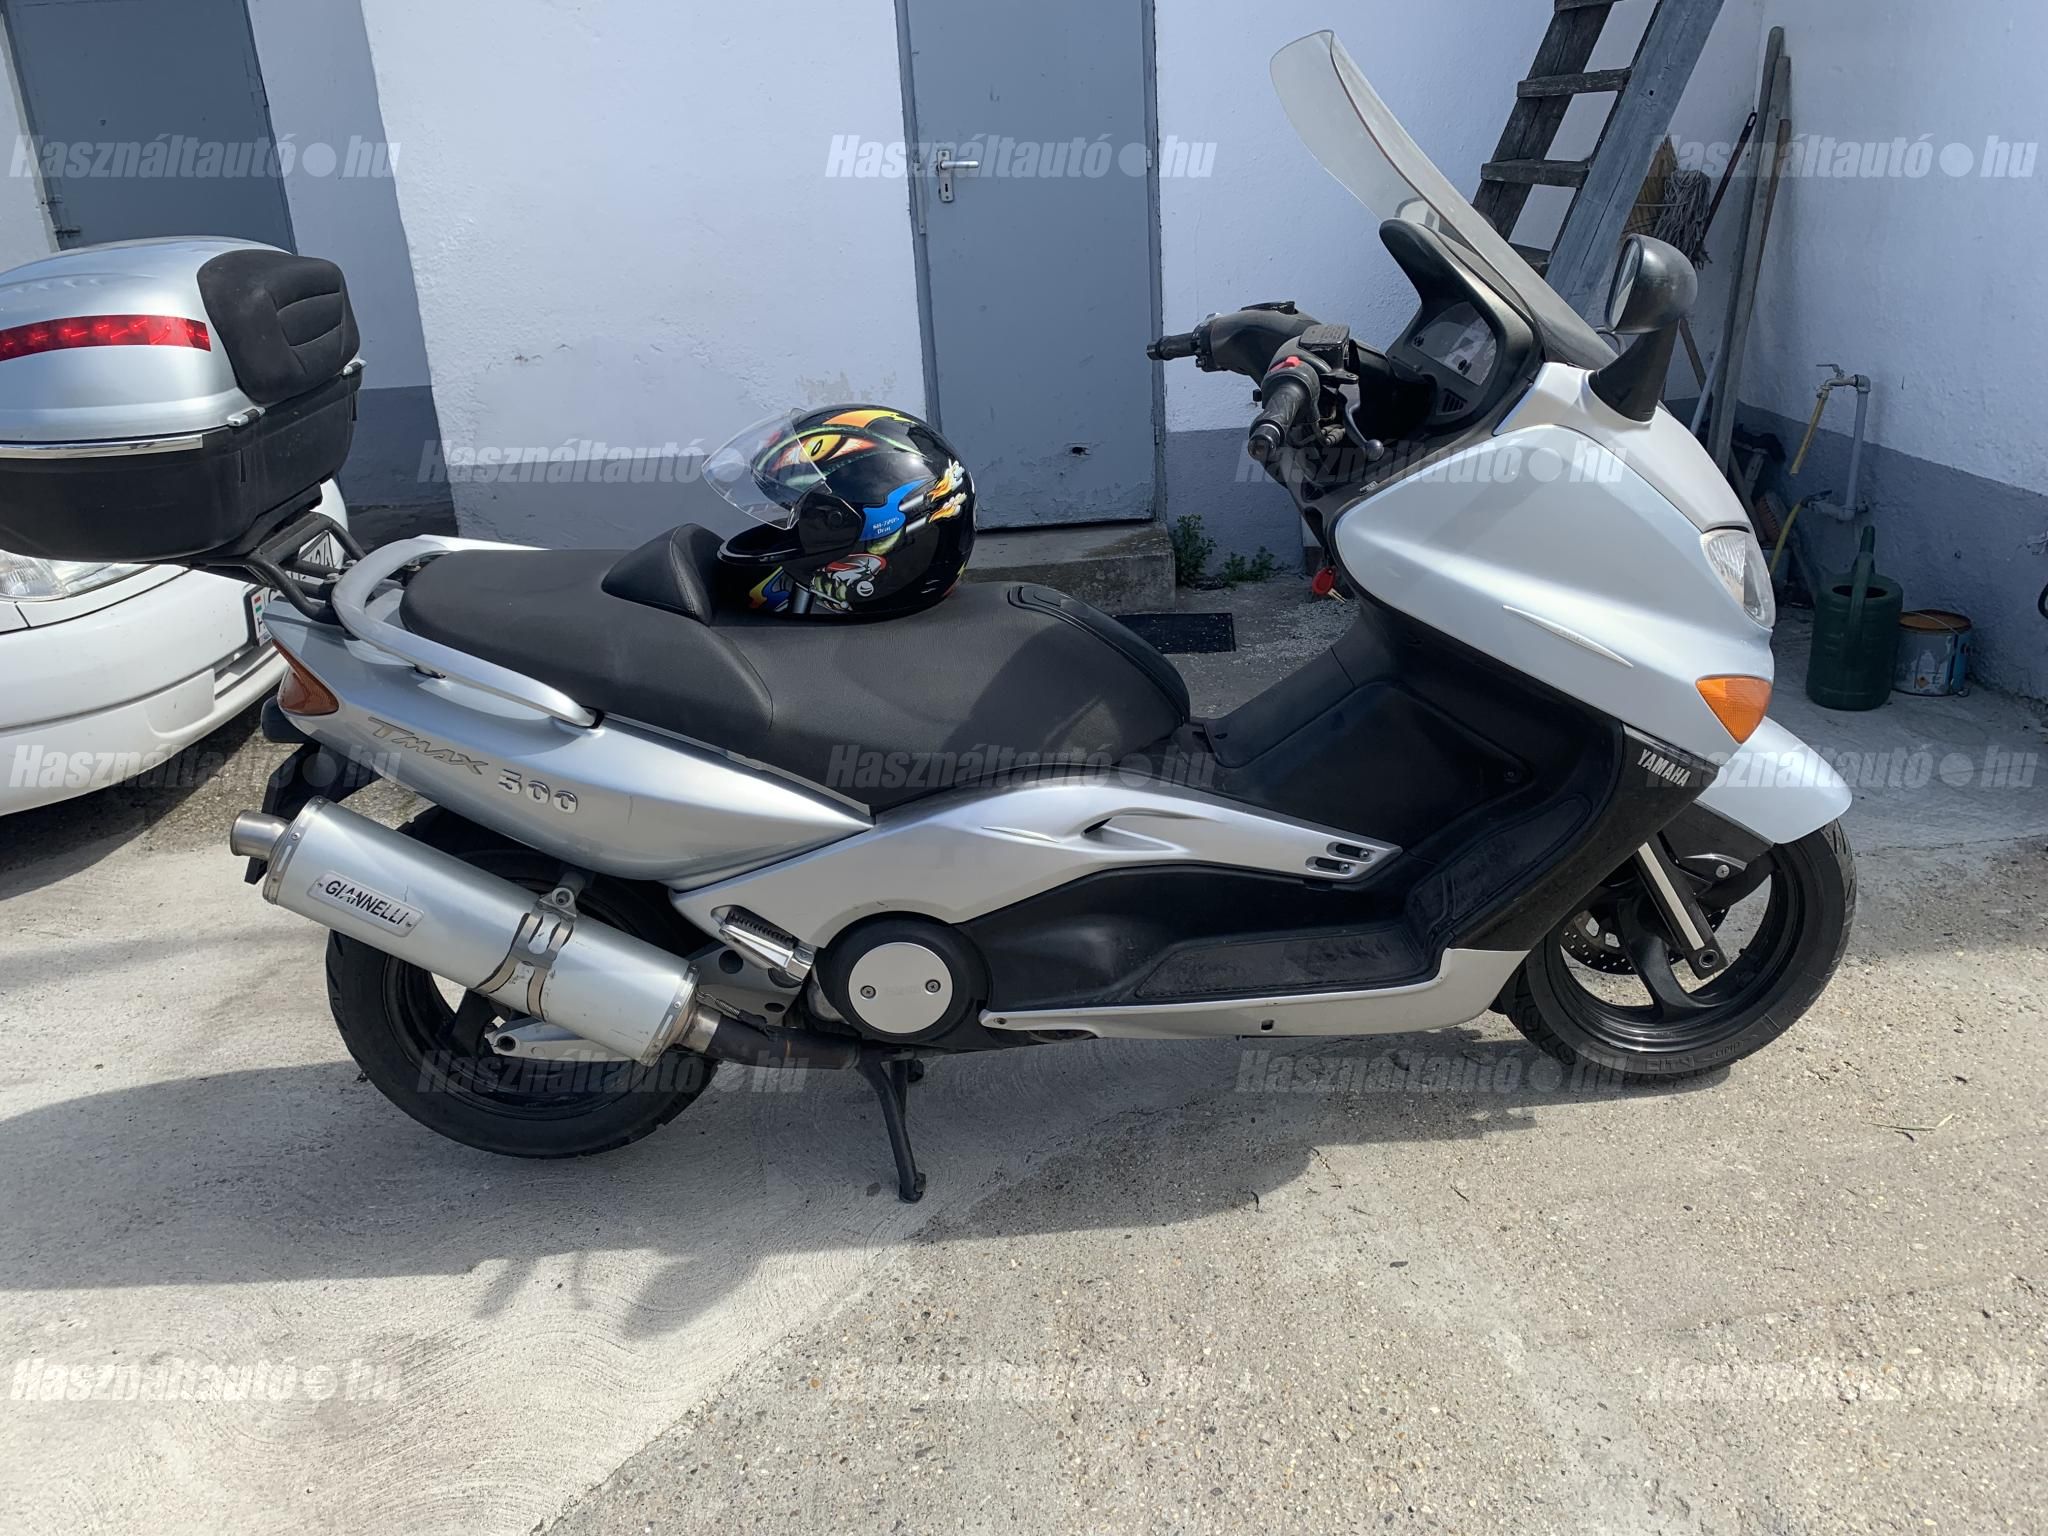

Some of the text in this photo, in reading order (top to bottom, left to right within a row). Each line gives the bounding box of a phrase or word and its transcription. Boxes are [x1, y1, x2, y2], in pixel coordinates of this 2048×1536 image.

[368, 716, 578, 814] TMAX 500
[1637, 749, 1691, 787] YAMAHA
[325, 880, 409, 925] GIANNELLI
